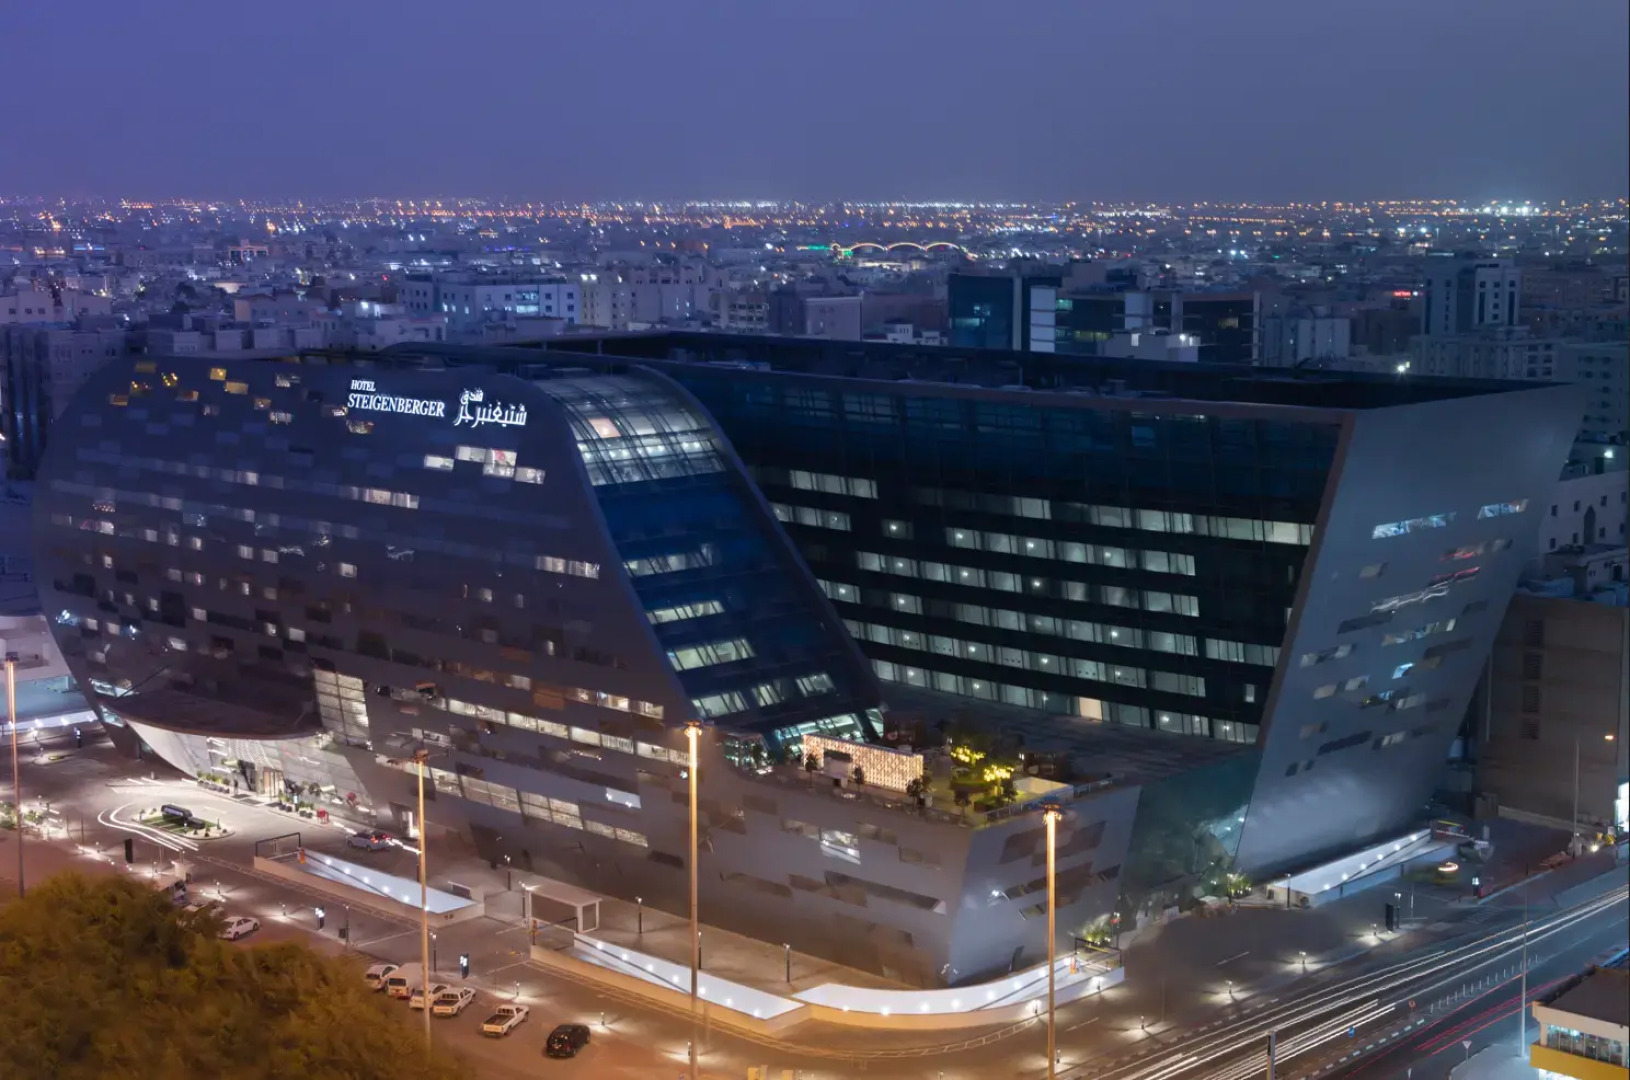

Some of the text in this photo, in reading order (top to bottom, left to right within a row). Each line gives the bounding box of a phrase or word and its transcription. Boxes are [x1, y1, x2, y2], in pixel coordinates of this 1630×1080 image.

[351, 380, 376, 391] HOTEL
[460, 389, 484, 404] فندق
[347, 393, 445, 417] STEIGENBERGER
